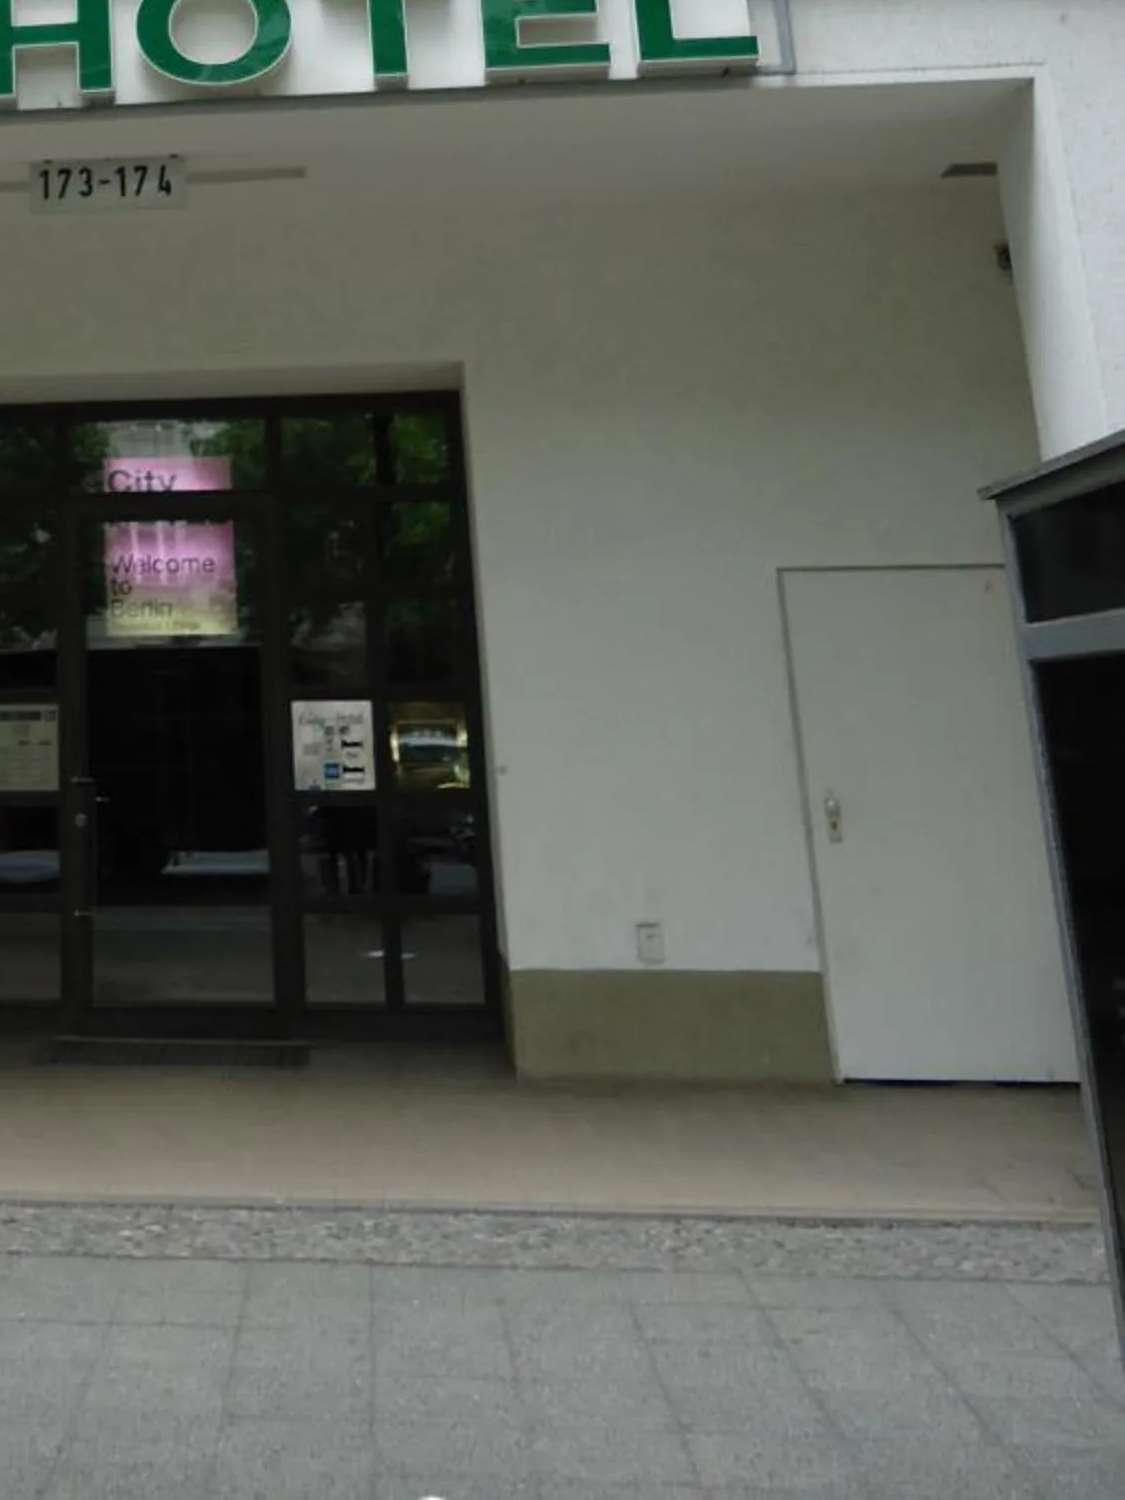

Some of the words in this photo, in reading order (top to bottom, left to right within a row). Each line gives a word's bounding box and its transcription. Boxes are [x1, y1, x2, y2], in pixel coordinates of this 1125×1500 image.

[39, 164, 172, 200] 173-174
[112, 554, 216, 574] Welcome
[110, 578, 132, 596] to
[111, 598, 172, 618] Berlin
